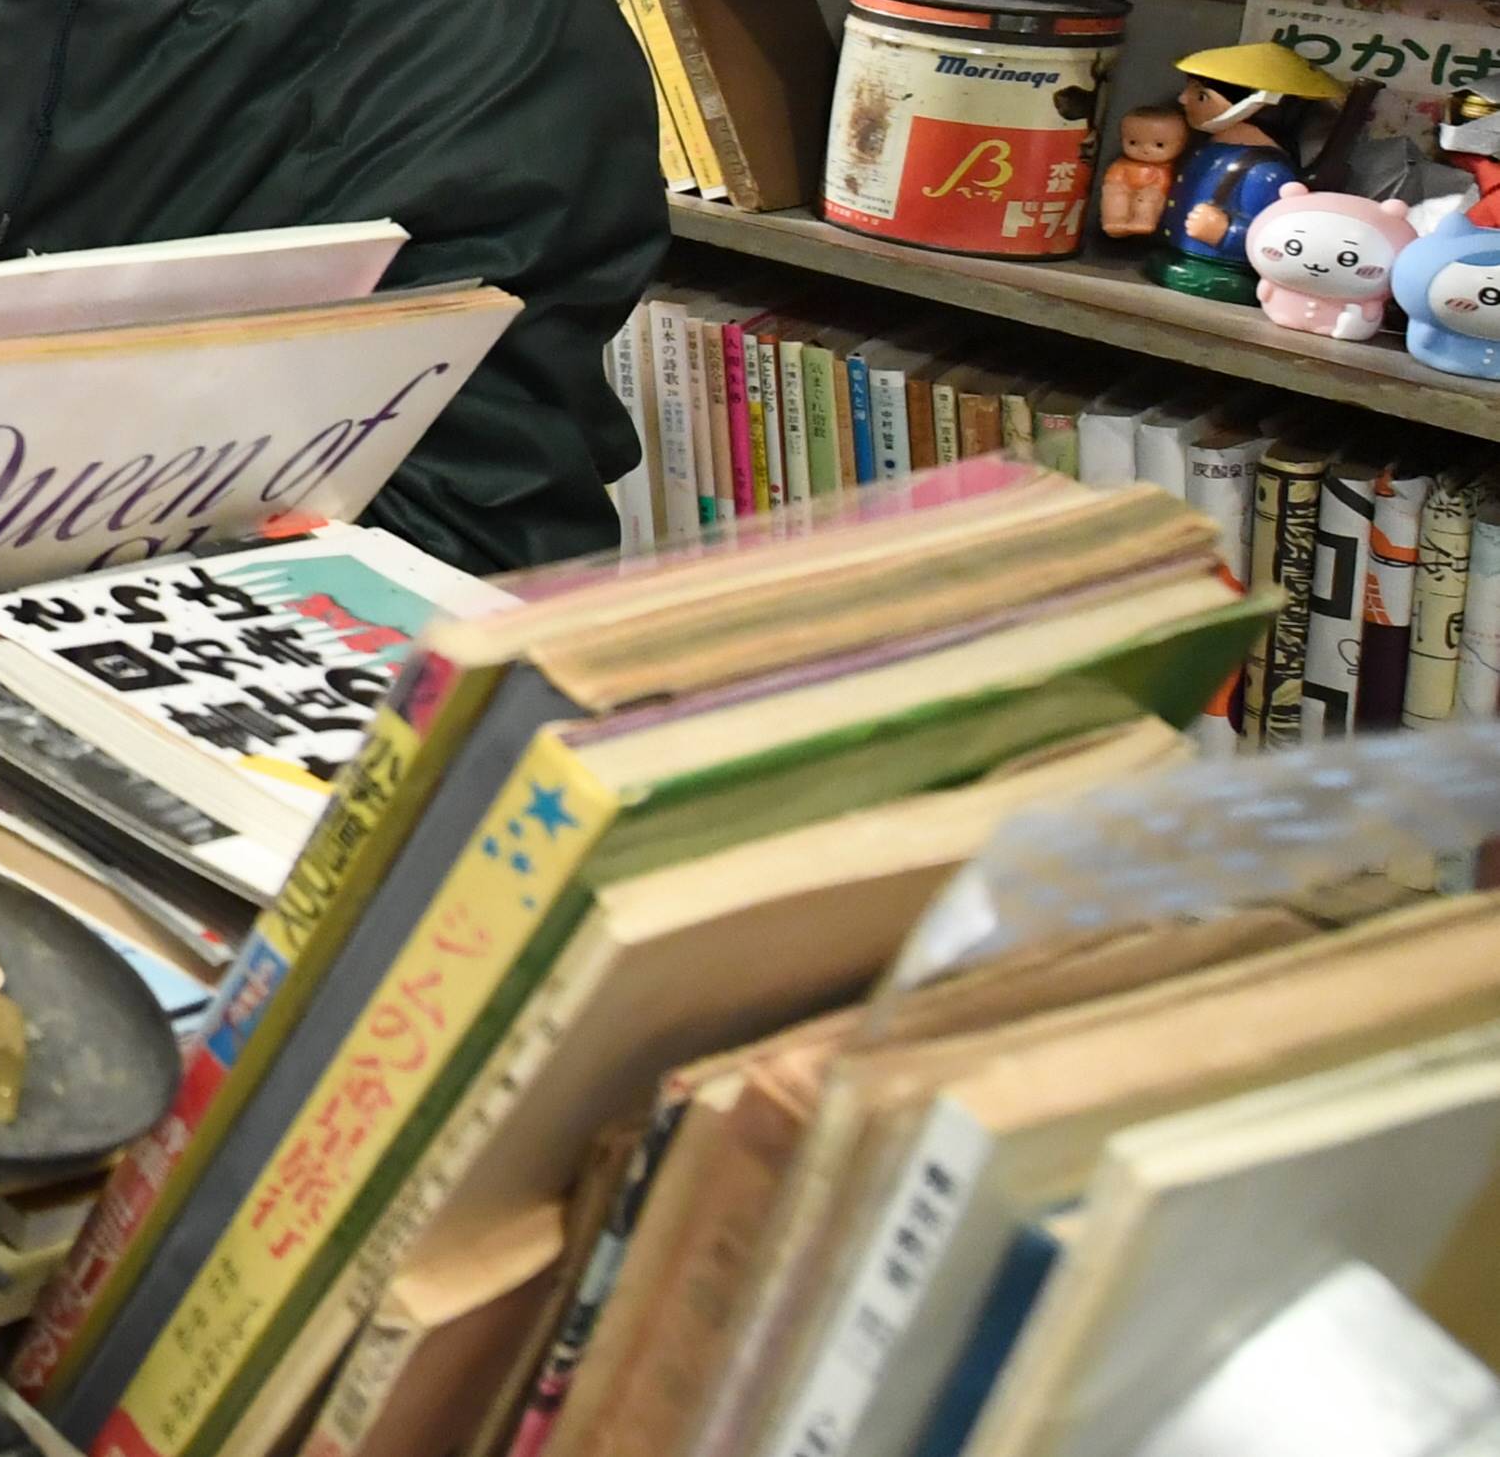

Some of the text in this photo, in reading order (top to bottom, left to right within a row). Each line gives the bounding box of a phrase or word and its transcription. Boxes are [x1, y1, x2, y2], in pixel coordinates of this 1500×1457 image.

[935, 54, 1060, 88] Morinaga
[660, 316, 681, 387] 日本の詩歌
[260, 361, 451, 522] of
